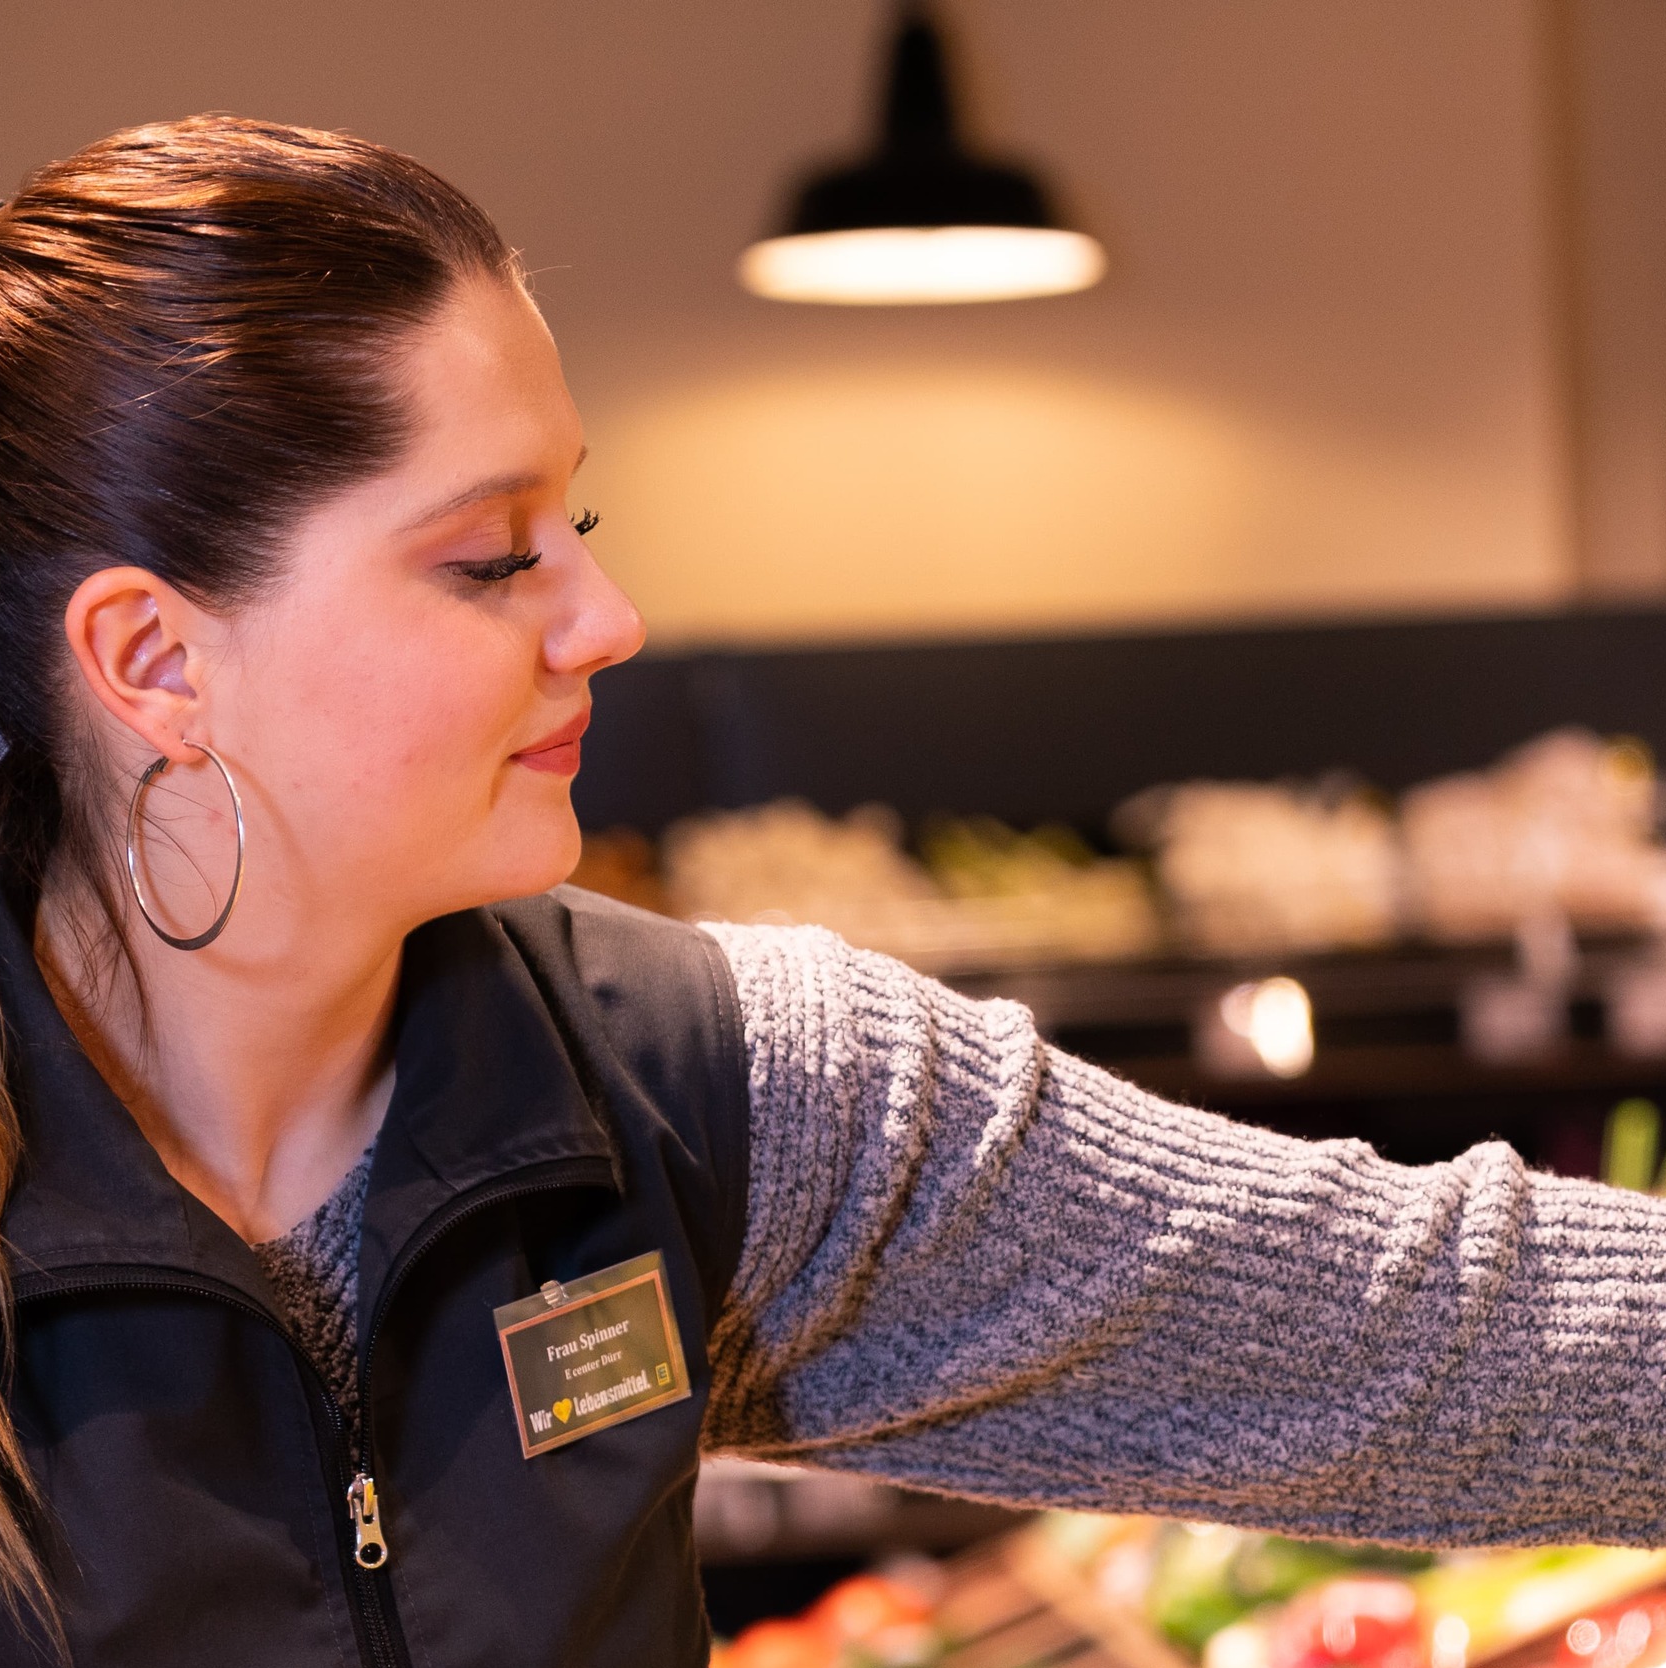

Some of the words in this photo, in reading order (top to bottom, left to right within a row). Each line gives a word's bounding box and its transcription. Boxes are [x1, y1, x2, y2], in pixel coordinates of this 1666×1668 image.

[546, 1340, 578, 1362] Frau
[579, 1318, 630, 1350] Spinner
[565, 1368, 572, 1380] E
[572, 1360, 600, 1378] center
[601, 1349, 623, 1368] Dürr
[530, 1408, 553, 1433] Wir
[573, 1369, 652, 1416] Lebensmittel.
